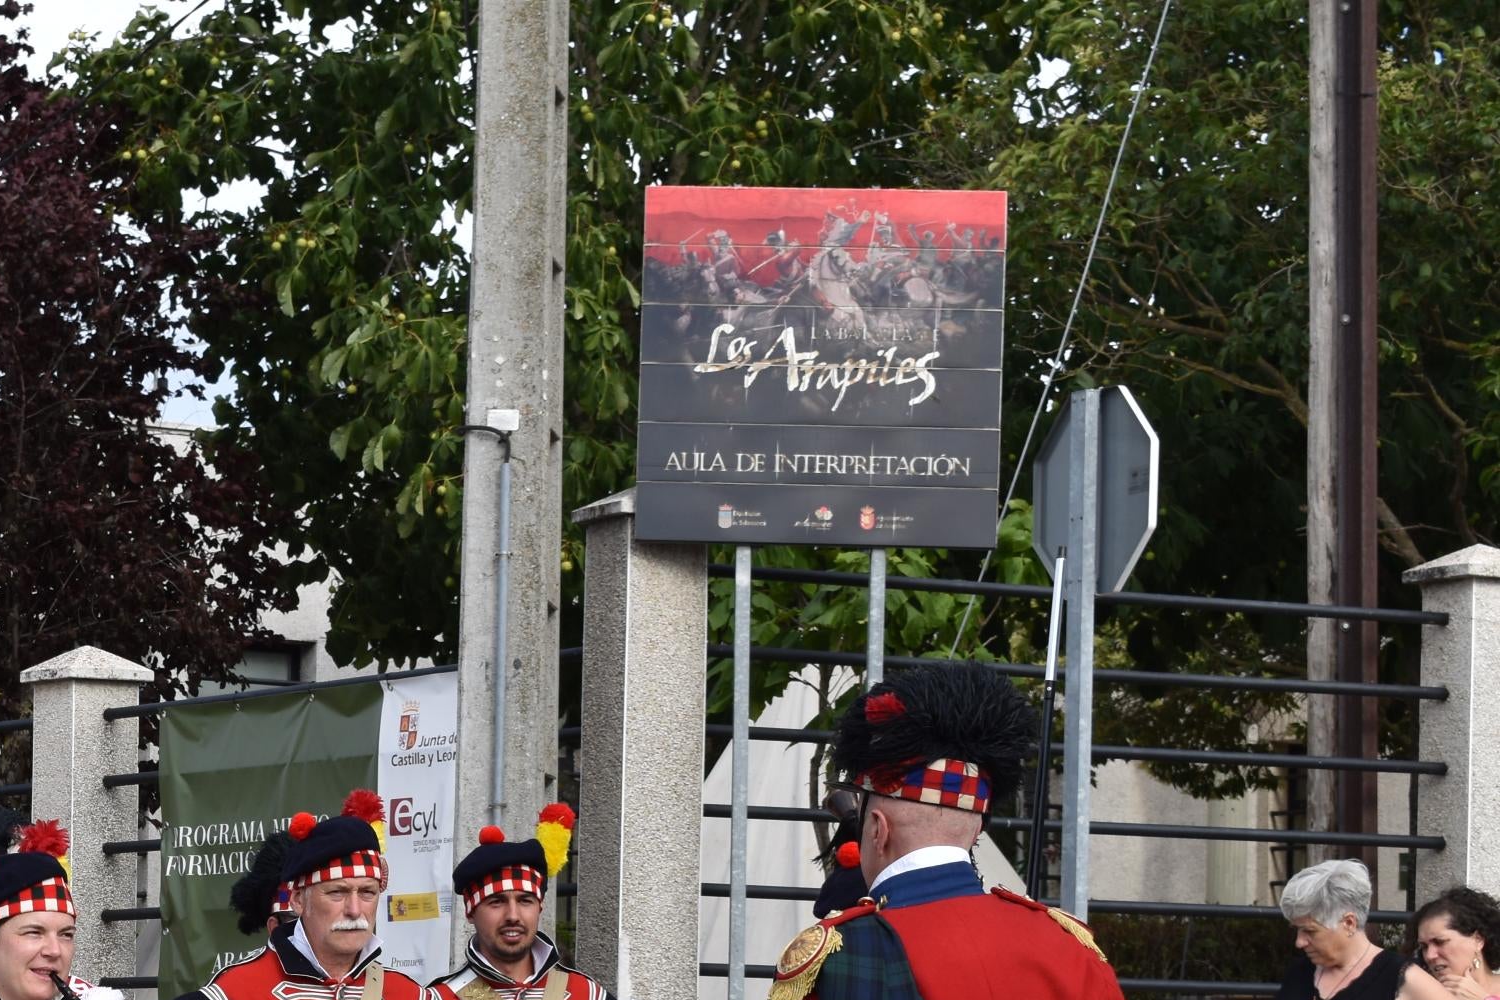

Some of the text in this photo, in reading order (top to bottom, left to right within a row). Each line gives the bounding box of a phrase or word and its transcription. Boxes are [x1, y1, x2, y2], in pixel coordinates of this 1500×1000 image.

[693, 323, 940, 411] Los Arapiles
[664, 452, 971, 477] AULA DE INTERPRETACIÓN
[418, 735, 447, 748] Junta
[390, 752, 426, 767] Castilla
[427, 754, 434, 768] y
[394, 799, 438, 838] ecyl
[165, 845, 261, 877] FORMACIÓ
